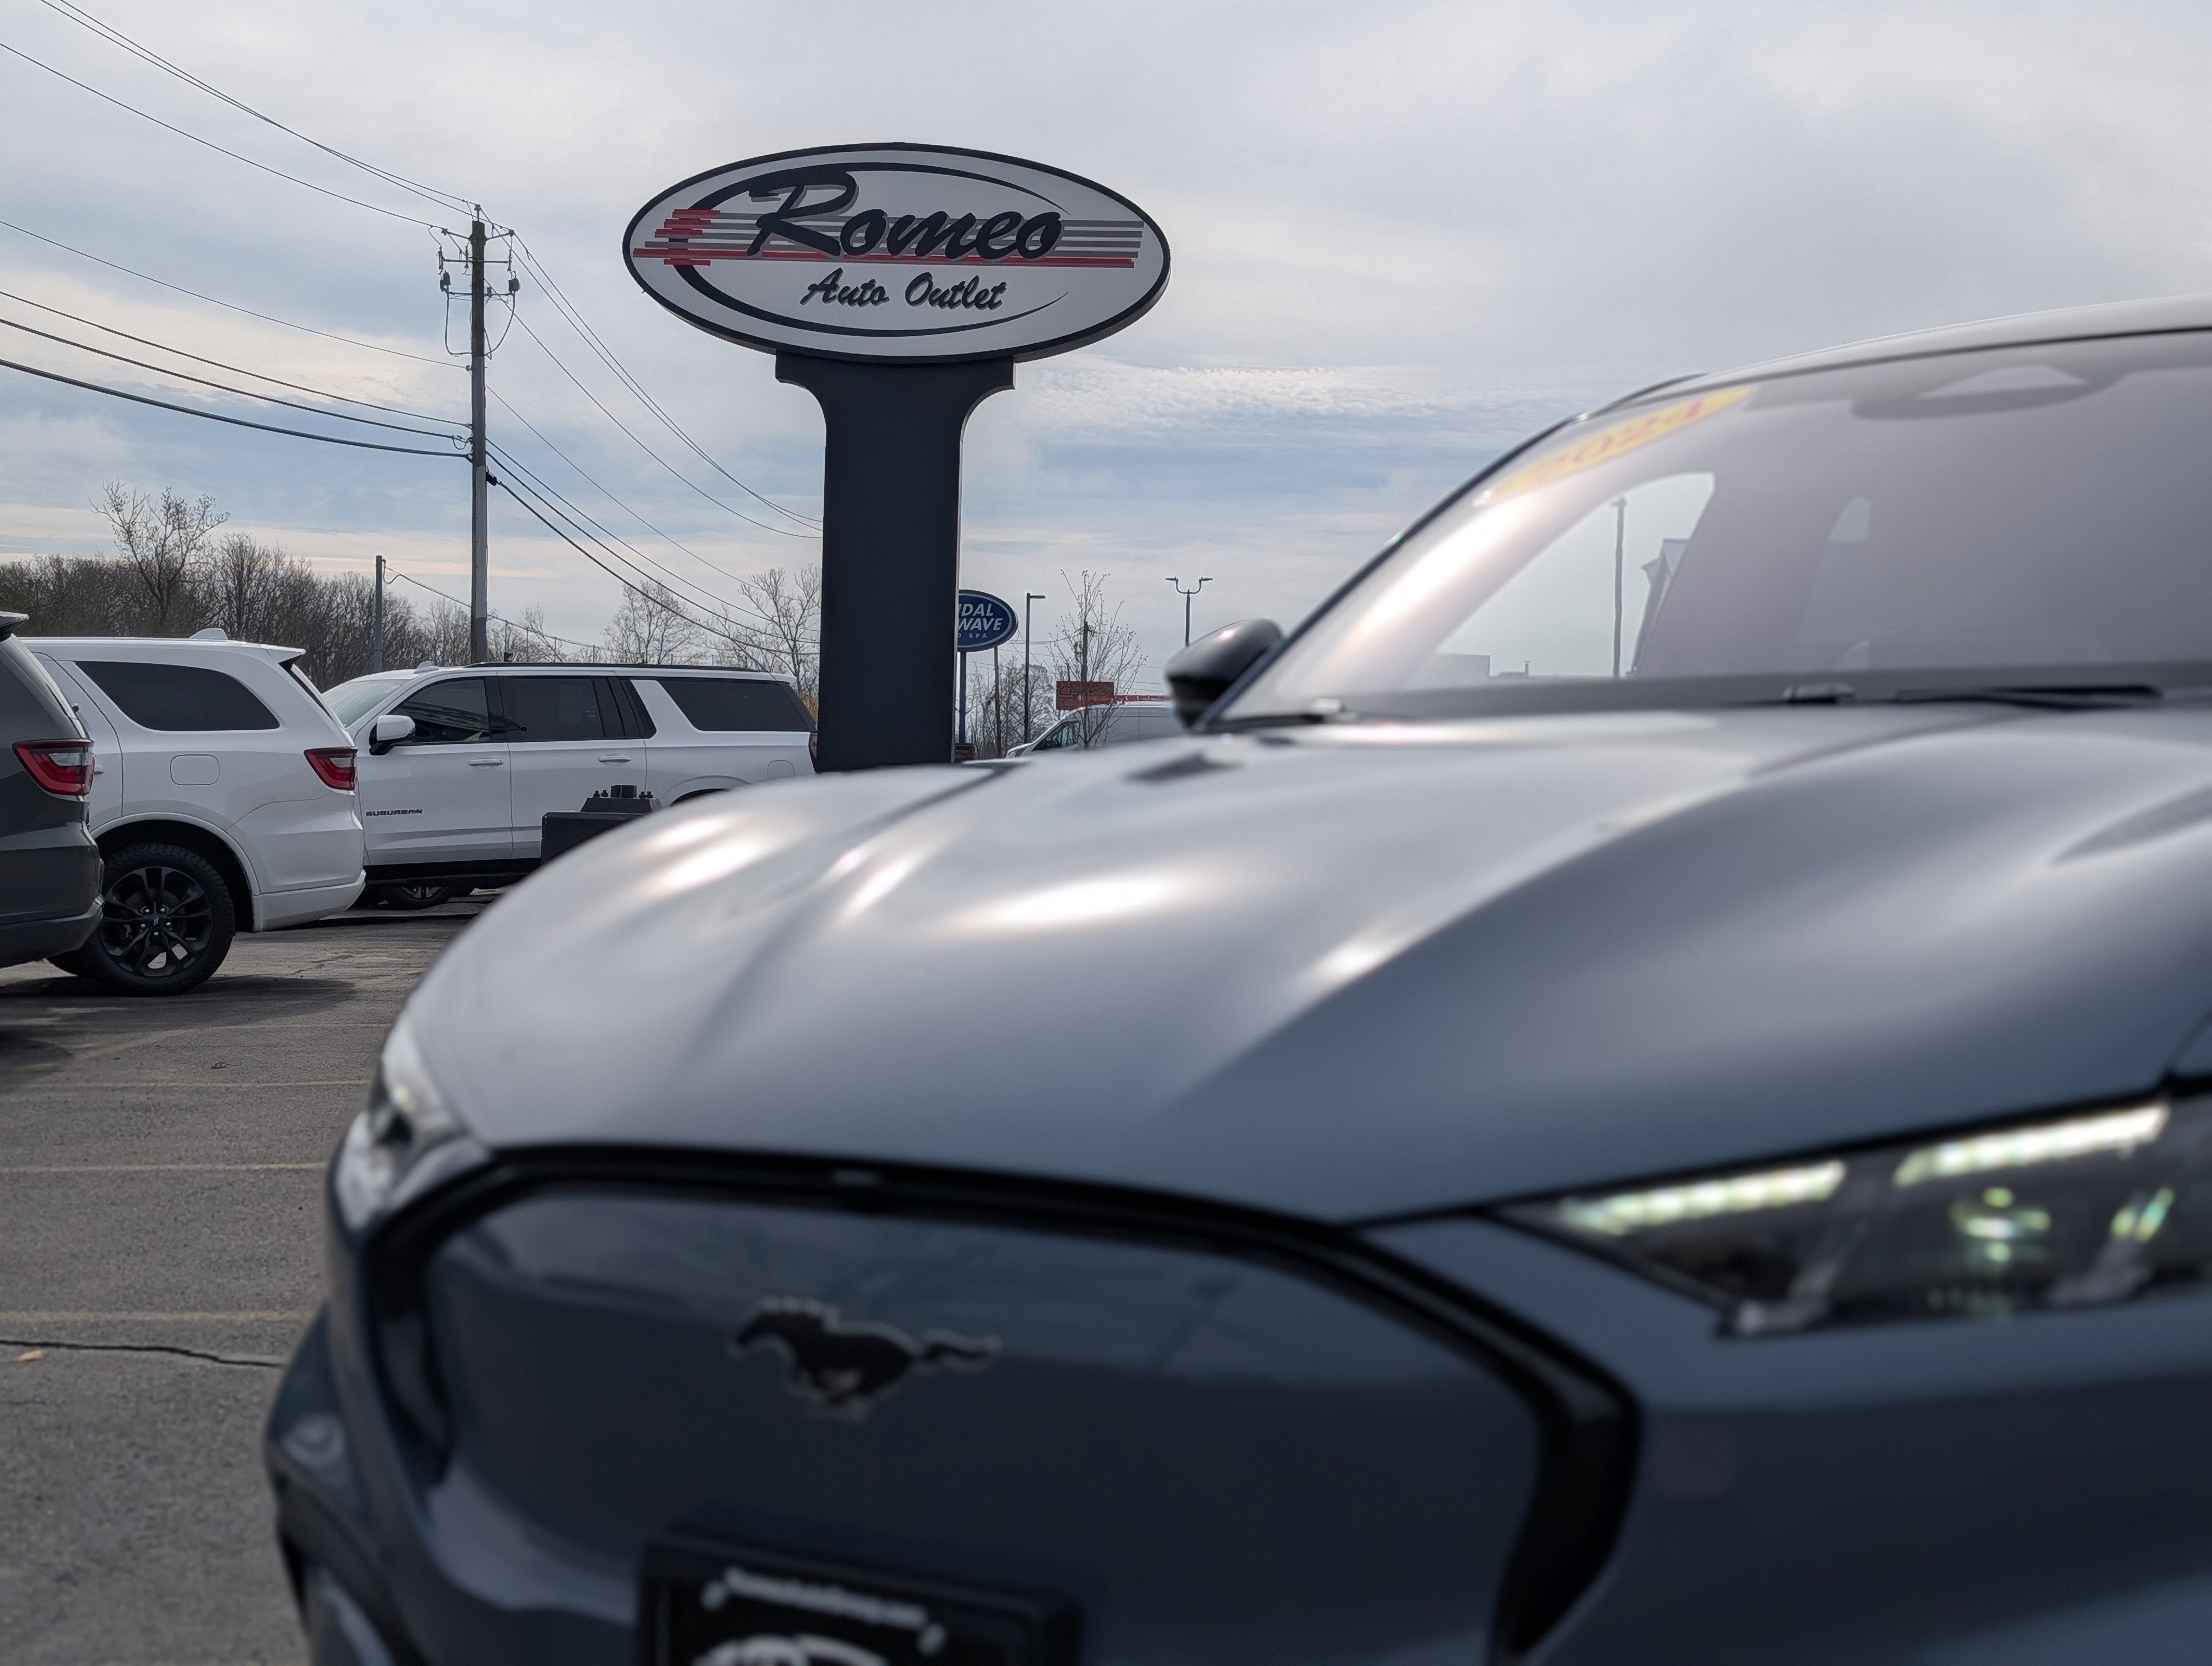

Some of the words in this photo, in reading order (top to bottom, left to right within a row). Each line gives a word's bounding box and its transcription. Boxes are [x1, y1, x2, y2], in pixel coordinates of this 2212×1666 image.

[747, 164, 1063, 260] Romeo
[800, 267, 890, 307] Auto
[905, 272, 1007, 310] Outlet
